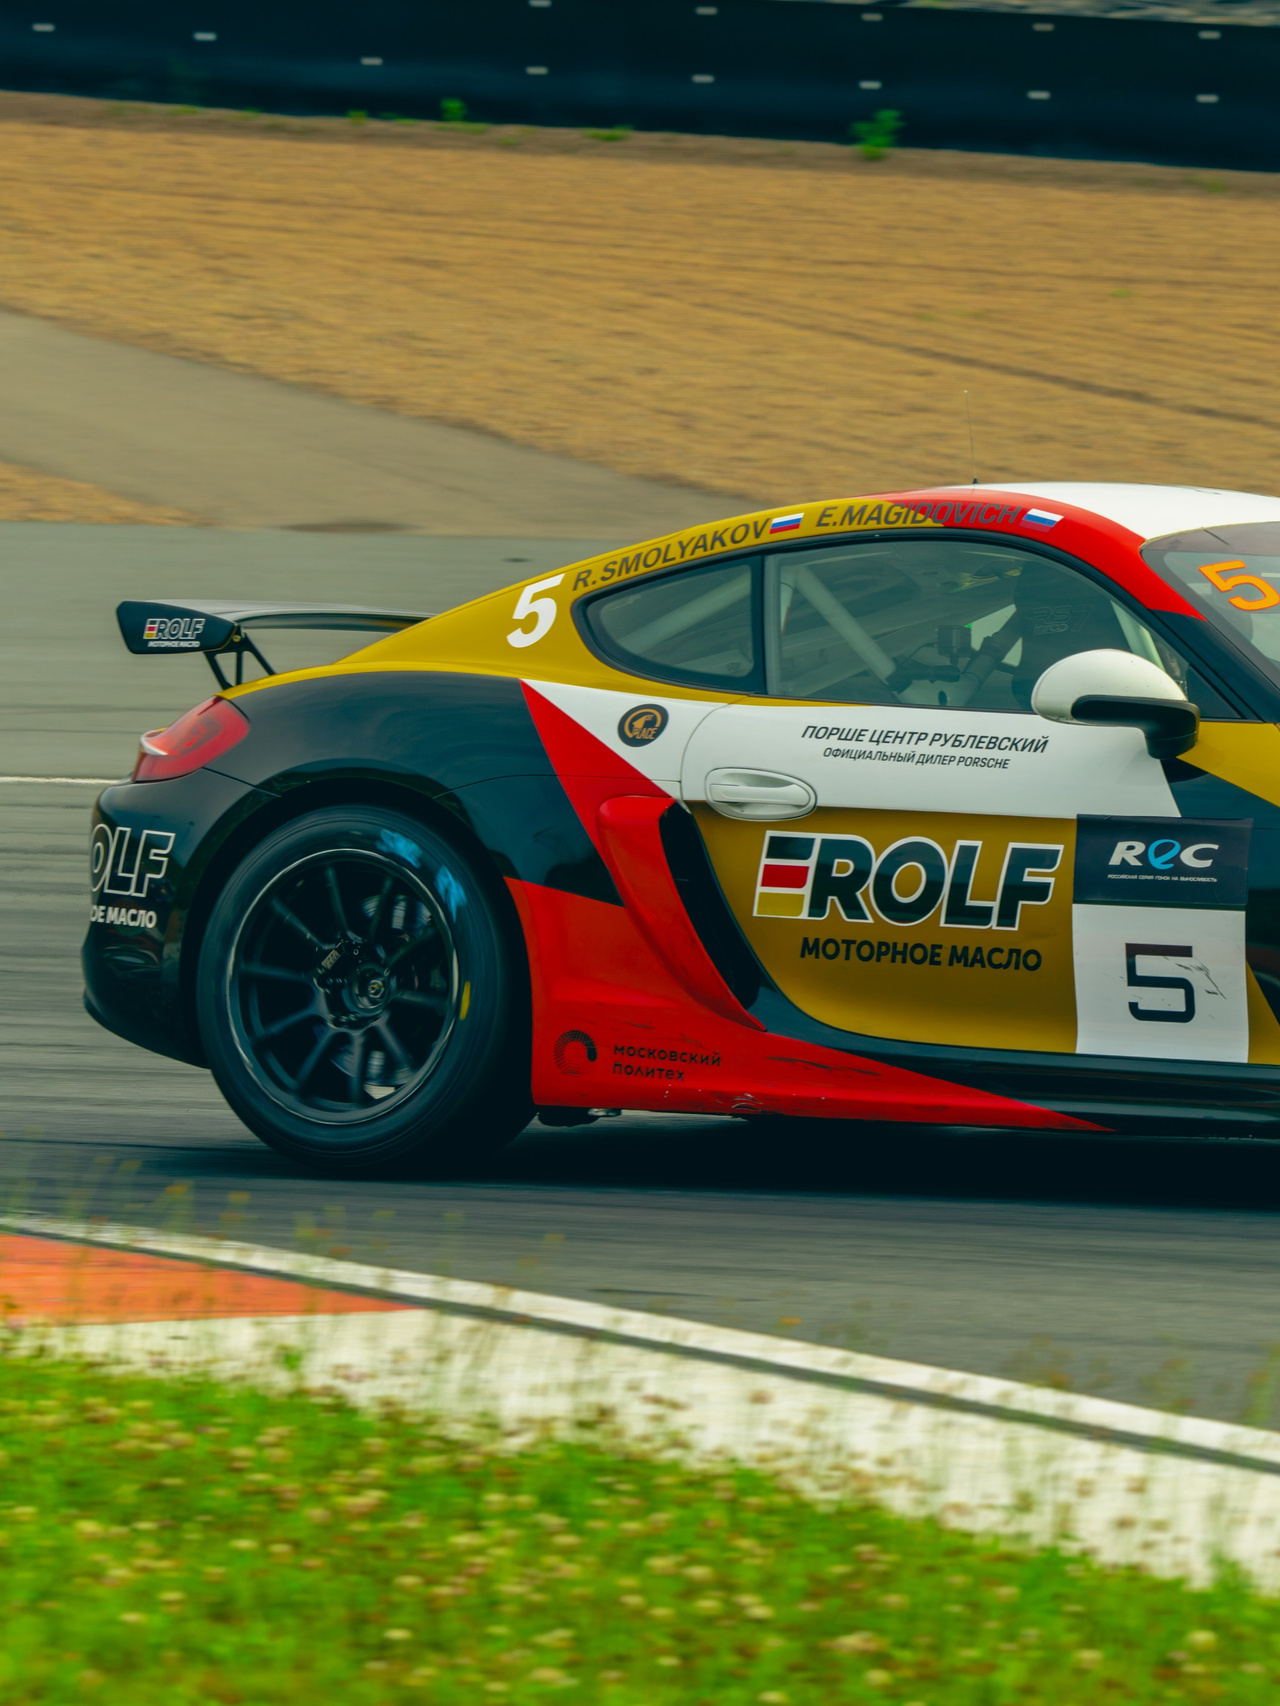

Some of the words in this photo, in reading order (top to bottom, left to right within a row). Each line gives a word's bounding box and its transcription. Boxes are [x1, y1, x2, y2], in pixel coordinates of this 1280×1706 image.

[816, 502, 1023, 528] E.MAGIDOVICH
[572, 517, 771, 591] R.SMOLYAKOV
[1198, 560, 1280, 611] 5
[506, 573, 566, 648] 5
[154, 618, 206, 640] ROLF
[801, 725, 869, 743] ПОРШЕ
[868, 729, 929, 747] ЦЕНТР
[929, 733, 1050, 754] РУБЛЕВСКИЙ
[823, 747, 916, 763] ОФИЦИАЛЬНЫЙ
[915, 754, 956, 767] ДИЛЕР
[956, 757, 1011, 769] PORSCHE
[804, 833, 1064, 931] ROLF
[106, 906, 157, 928] МАСЛО
[800, 937, 943, 966] МОТОРНОЕ
[948, 945, 1043, 971] МАСЛО
[1125, 943, 1196, 1023] 5
